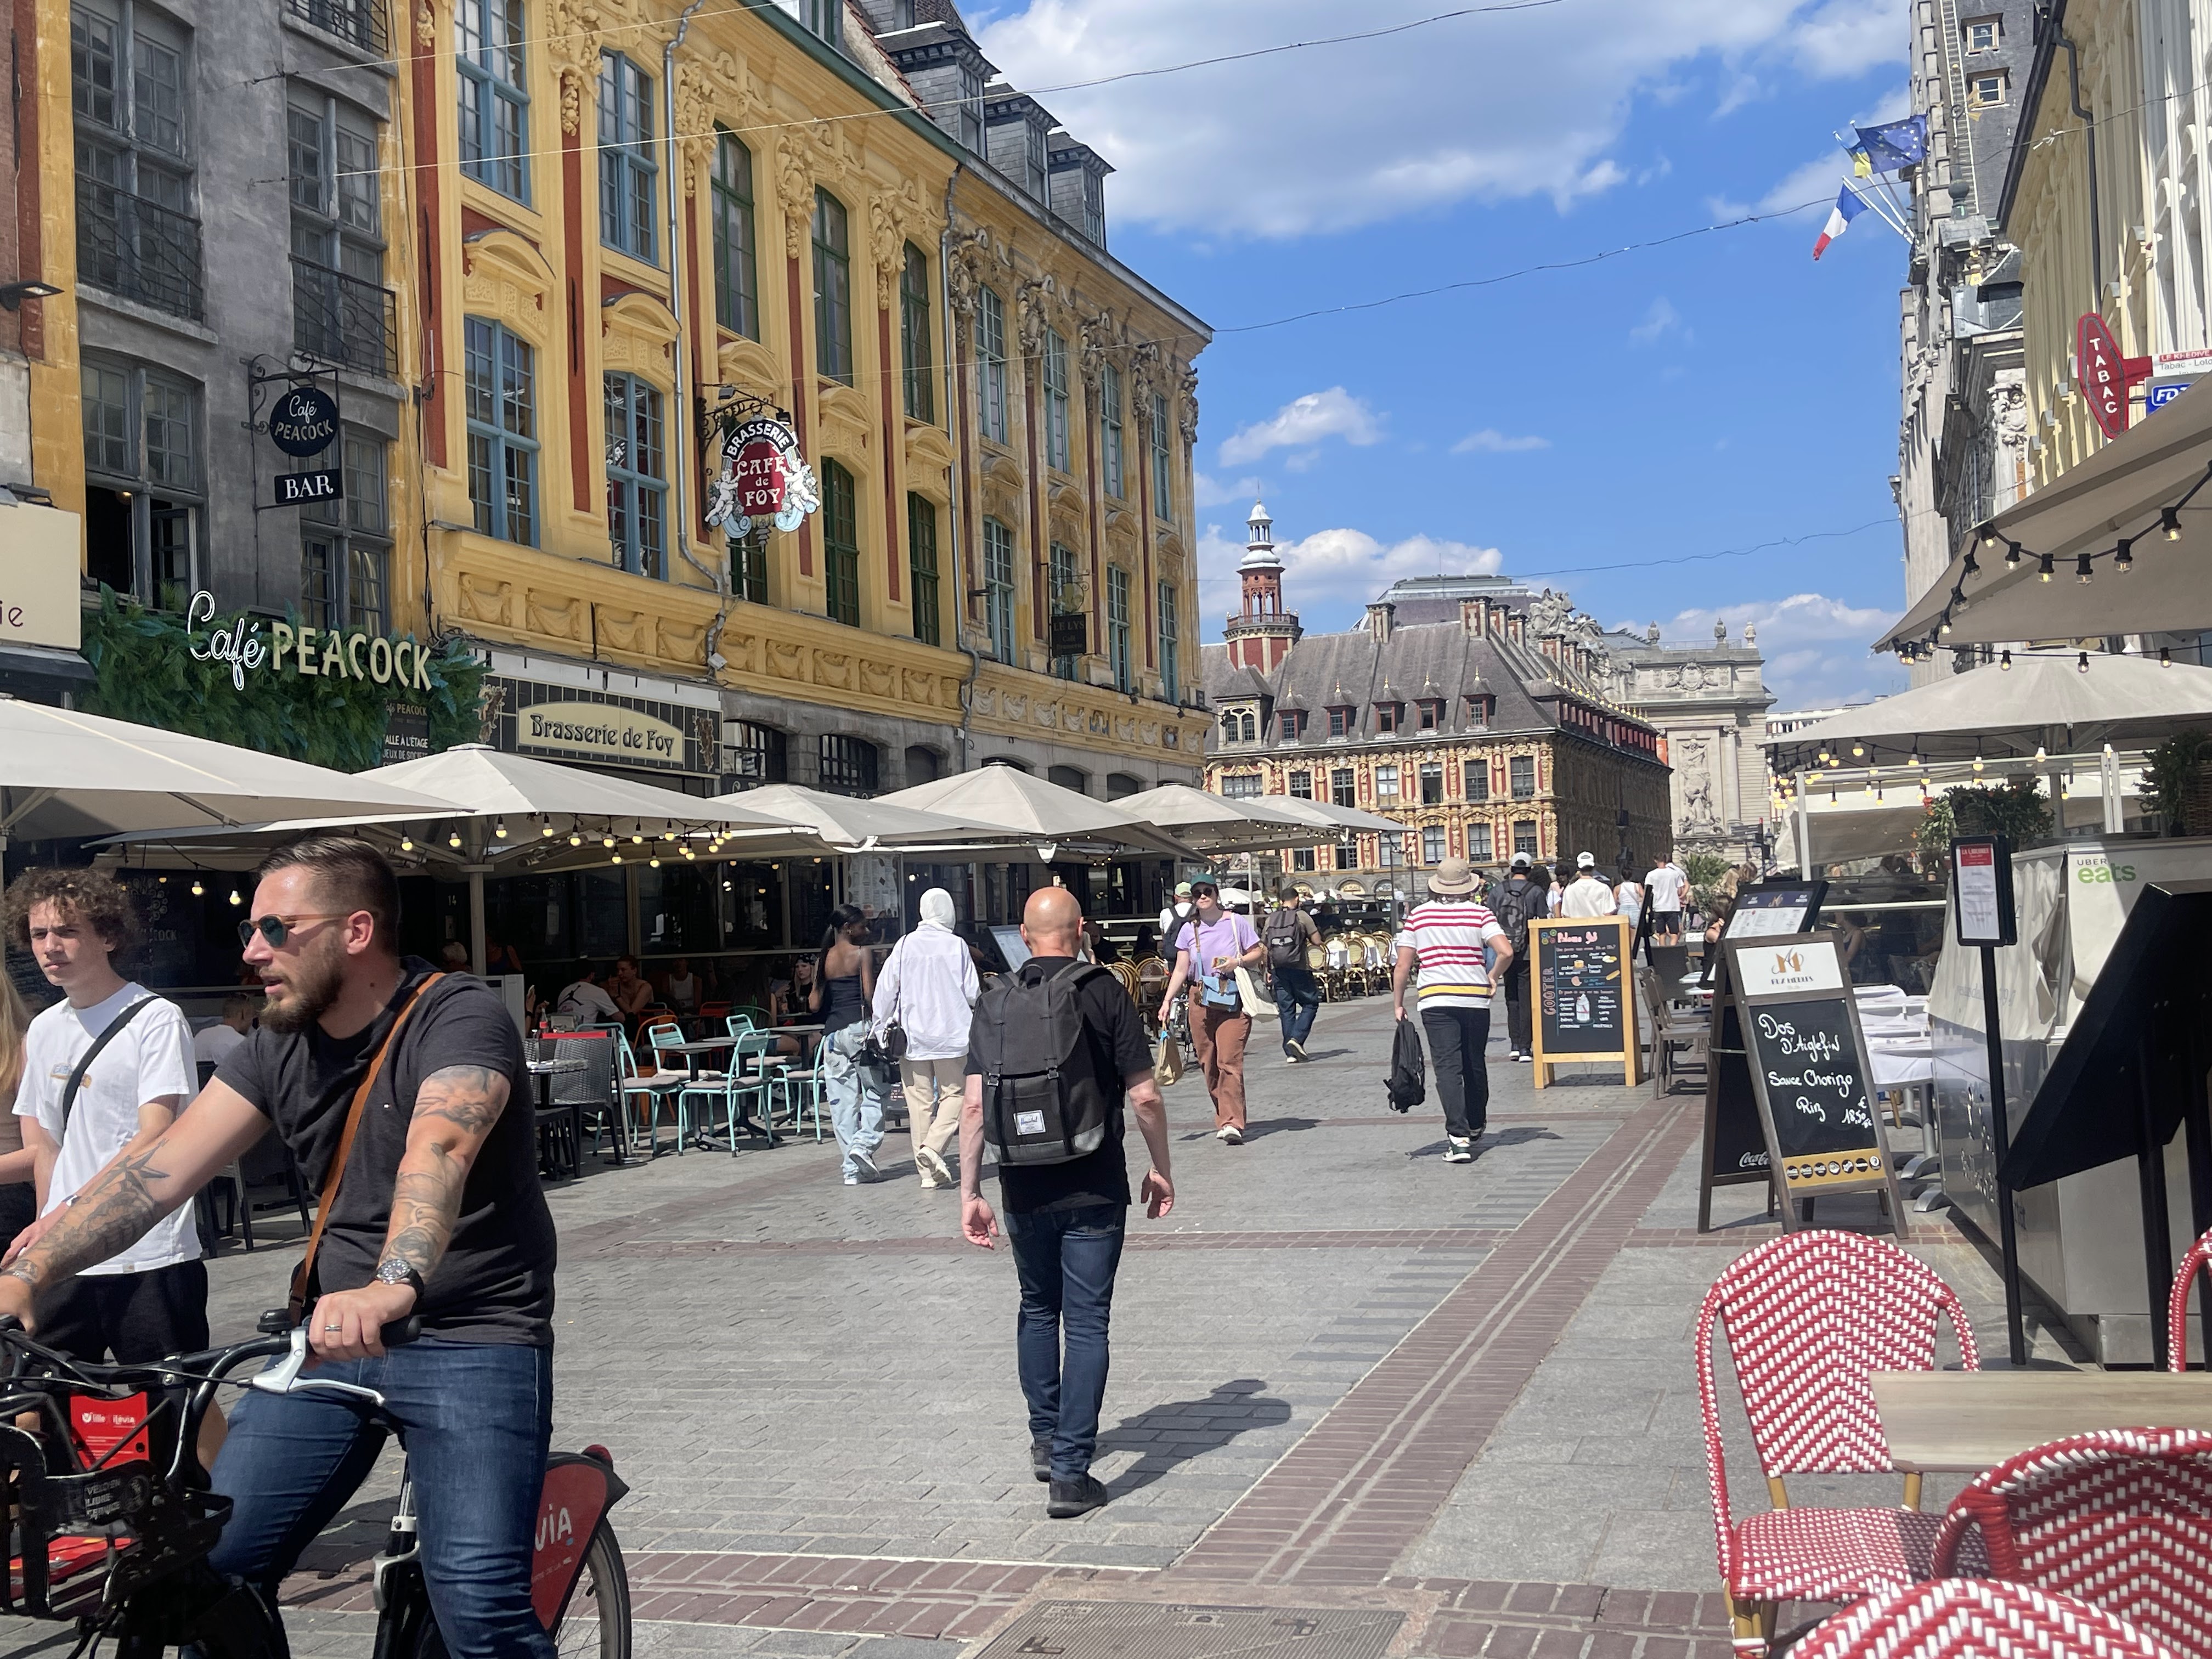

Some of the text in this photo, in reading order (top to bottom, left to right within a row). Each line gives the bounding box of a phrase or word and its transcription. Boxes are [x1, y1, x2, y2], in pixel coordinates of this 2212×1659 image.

[2089, 337, 2118, 414] TABAC
[2161, 362, 2186, 370] Tabac
[289, 394, 317, 424] Café
[274, 419, 334, 441] PEACOCK
[726, 422, 790, 456] BRASSERIE
[284, 475, 334, 499] BAR
[755, 476, 769, 487] de
[744, 487, 781, 507] FOY
[1068, 620, 1085, 630] LYS
[187, 590, 432, 691] Café PEACOCK
[397, 703, 427, 716] PEACOCK
[384, 734, 399, 745] ALLE
[531, 713, 675, 757] Brasserie de Foy
[382, 748, 398, 759] JEUX
[398, 750, 405, 759] DE
[2078, 863, 2136, 883] eats
[1758, 1013, 1795, 1039] Dos
[1768, 1069, 1853, 1098] Sauce Chorizo
[1796, 1096, 1826, 1122] Riz
